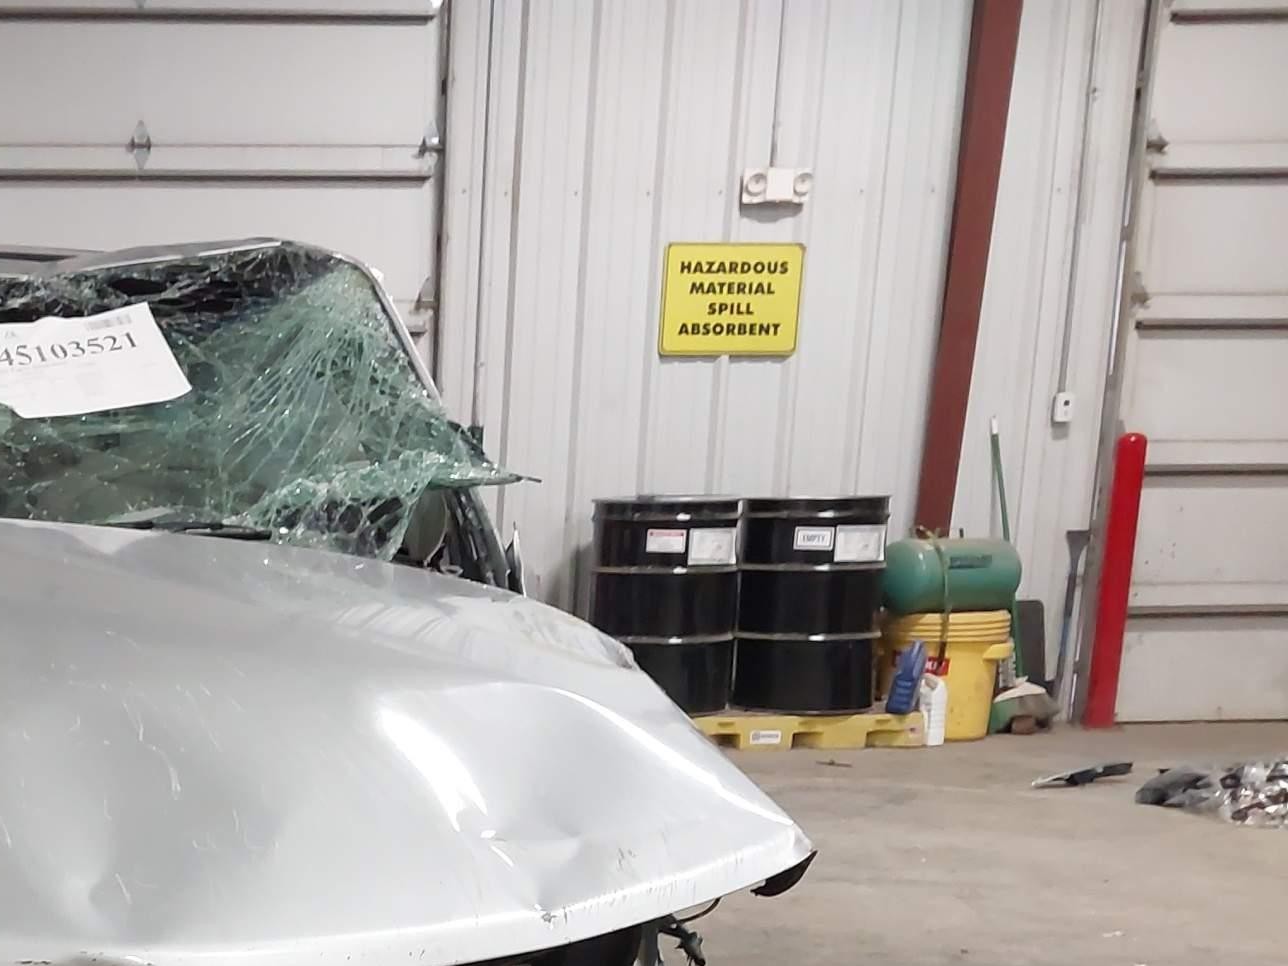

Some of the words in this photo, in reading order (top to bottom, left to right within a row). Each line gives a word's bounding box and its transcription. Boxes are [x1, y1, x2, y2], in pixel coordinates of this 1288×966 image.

[680, 261, 789, 275] HAZARDOUS
[689, 282, 775, 295] MATERIAL
[707, 302, 755, 316] SPILL
[678, 322, 781, 336] ABSORBENT
